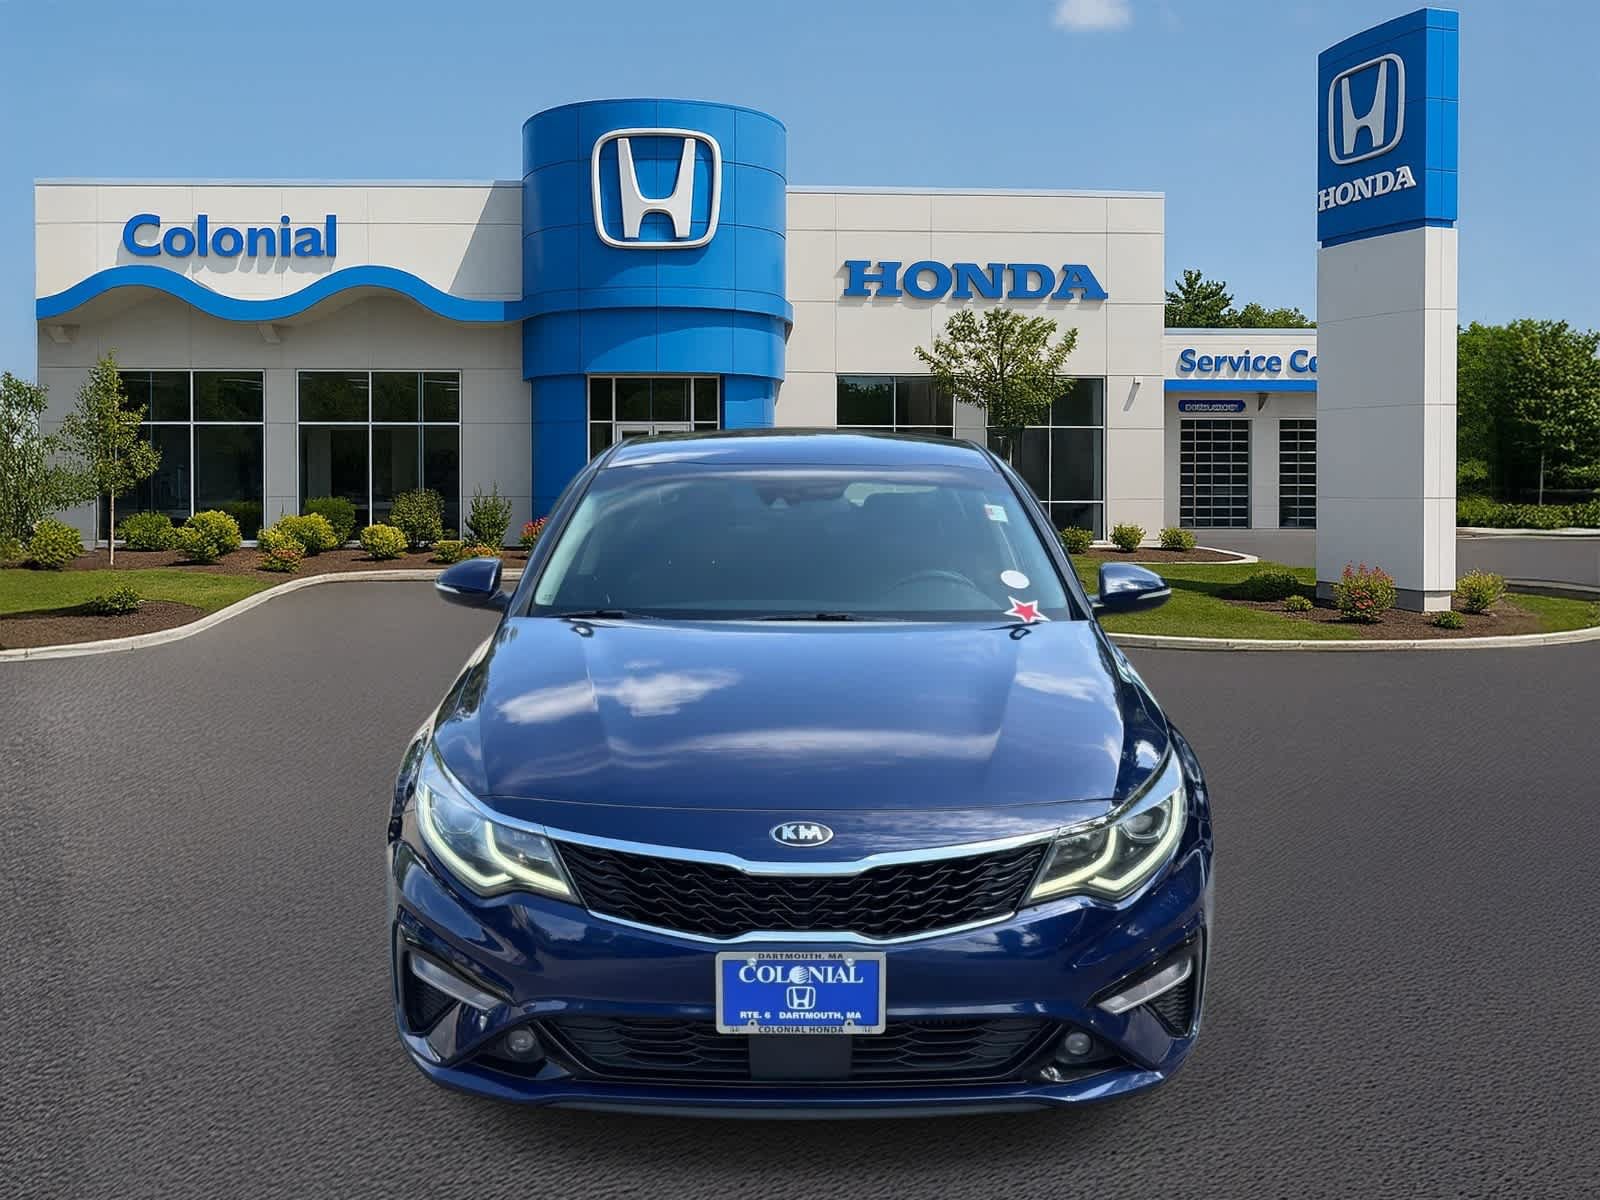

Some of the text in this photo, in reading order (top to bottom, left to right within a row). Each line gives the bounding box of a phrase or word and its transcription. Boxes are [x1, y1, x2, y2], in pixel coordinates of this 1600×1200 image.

[1318, 165, 1417, 212] HONDA
[122, 213, 337, 257] Colonial
[843, 260, 1109, 300] HONDA
[1180, 348, 1282, 373] Service
[738, 965, 864, 984] COLONIAL
[740, 1011, 862, 1021] RTE. 6 DARTMOUTH, MA
[758, 1025, 844, 1033] COLONIAL HONDA
